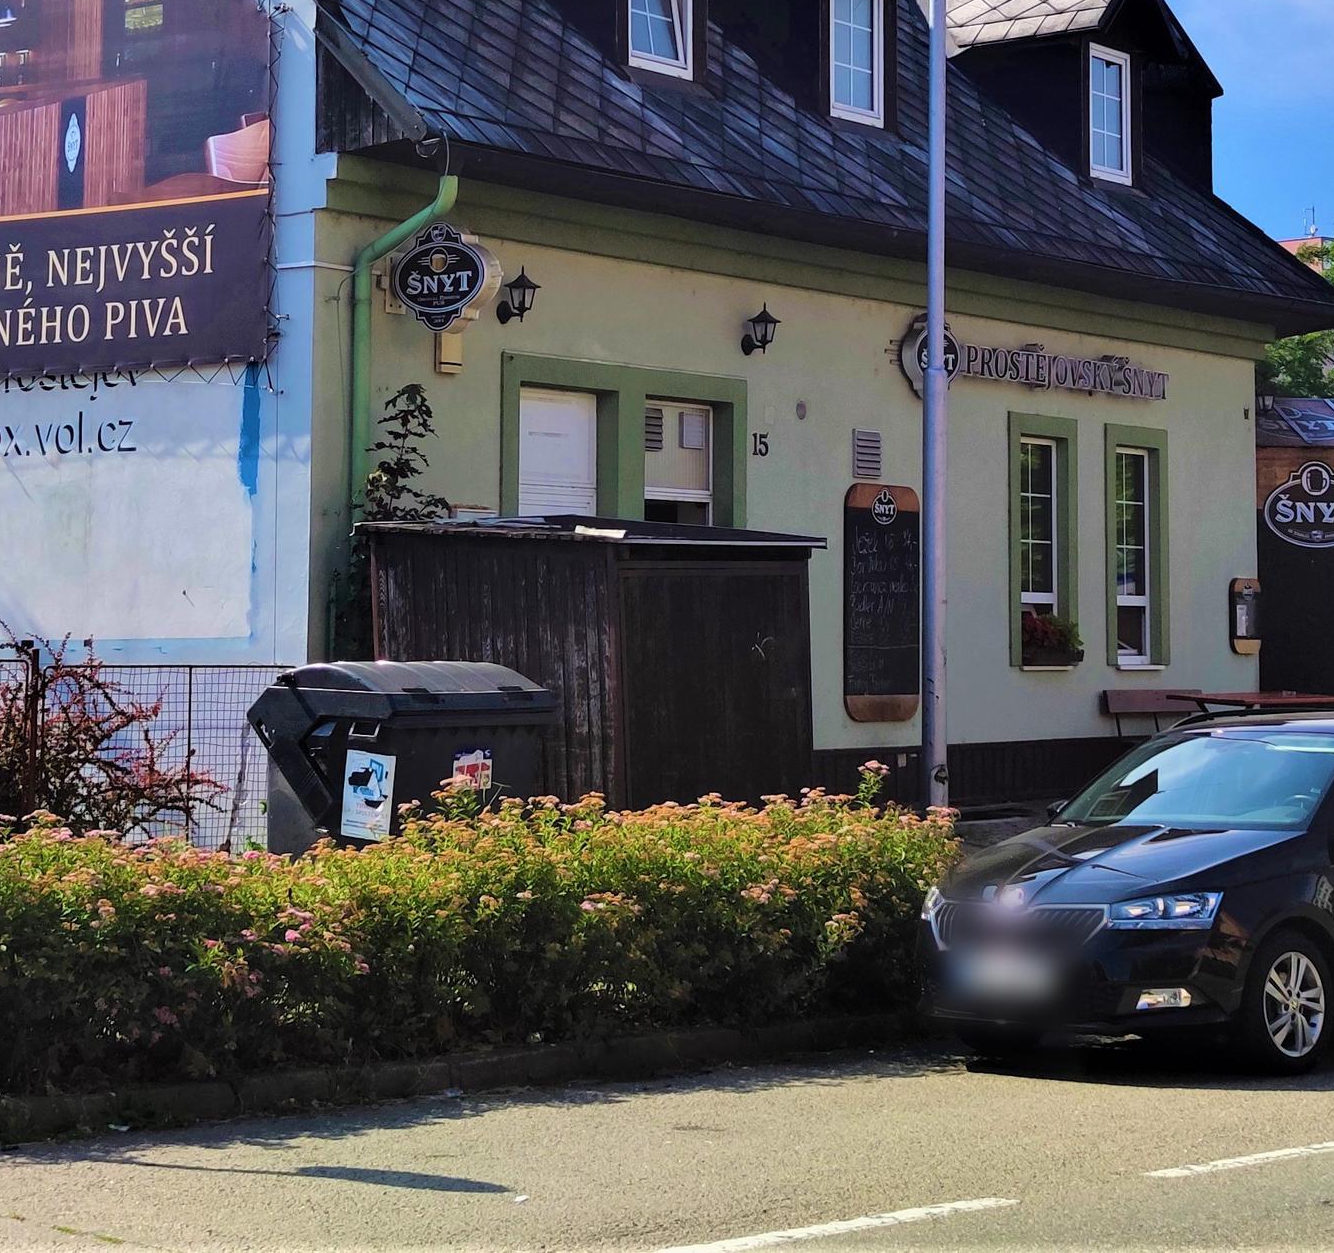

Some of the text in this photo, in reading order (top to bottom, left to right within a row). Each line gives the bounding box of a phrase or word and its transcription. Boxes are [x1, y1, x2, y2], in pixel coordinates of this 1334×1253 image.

[46, 224, 215, 293] NEJVYŠŠÍ
[406, 271, 473, 295] ŠNYT
[104, 296, 188, 340] PIVA
[966, 343, 1170, 400] PROSTĚJOVSKÝ ŠNYT
[752, 432, 769, 456] 15
[874, 501, 895, 515] ŠNYT
